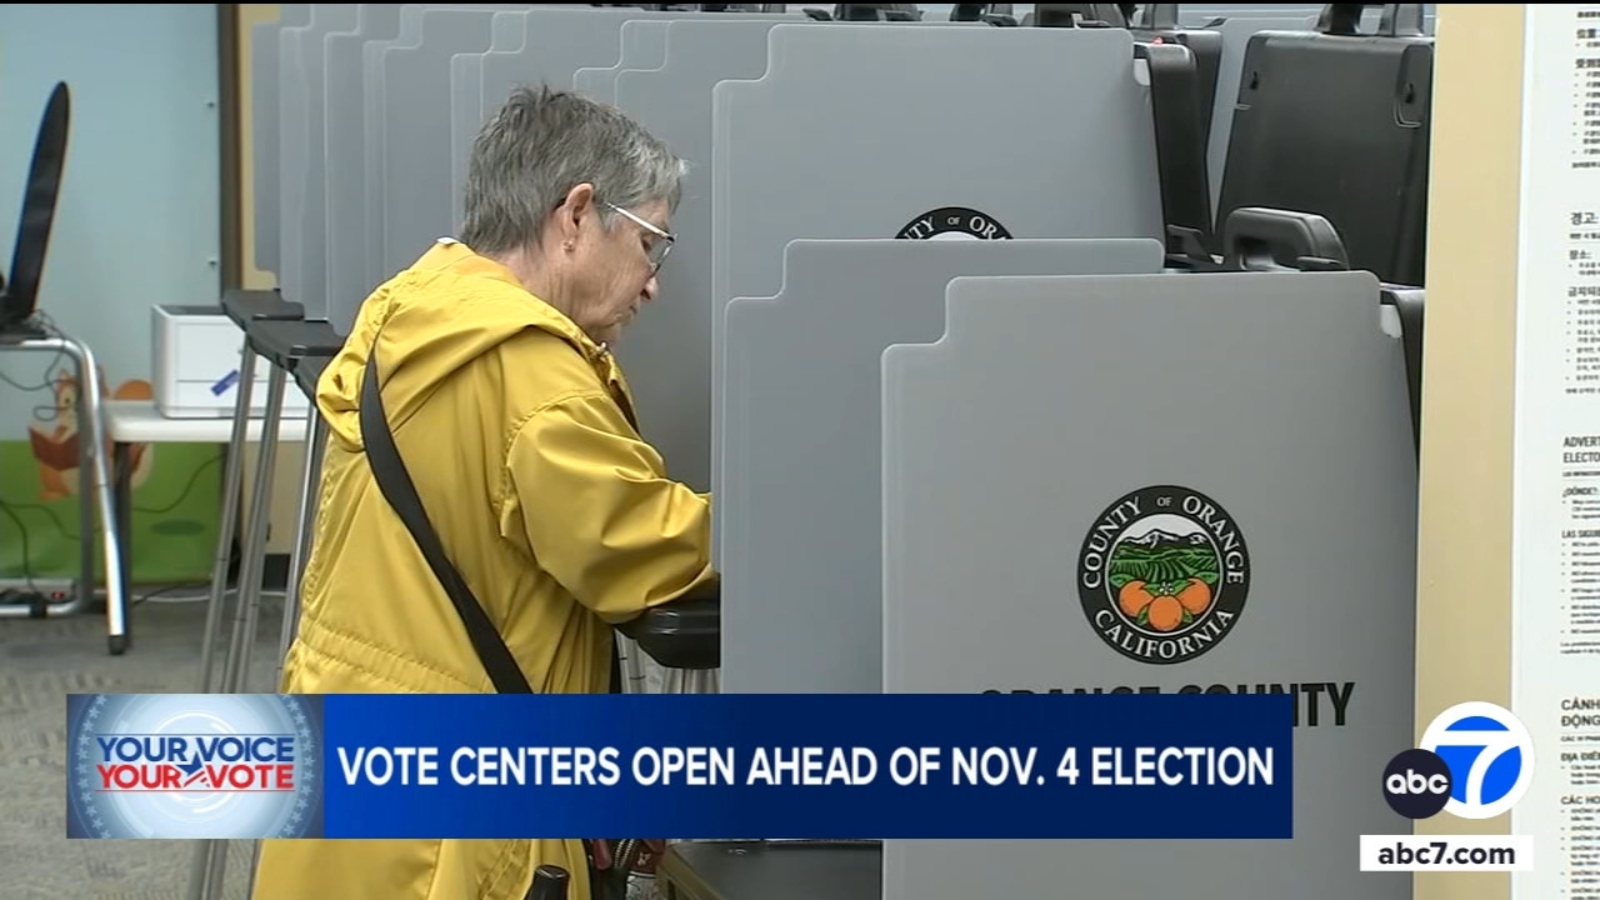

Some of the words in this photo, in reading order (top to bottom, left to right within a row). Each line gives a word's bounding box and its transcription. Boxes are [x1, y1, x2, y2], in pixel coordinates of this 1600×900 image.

[946, 216, 961, 226] OF
[1083, 496, 1142, 588] COUNTY
[1156, 496, 1173, 507] OF
[1182, 495, 1244, 584] ORANGE
[1095, 609, 1235, 659] CALIFORNIA
